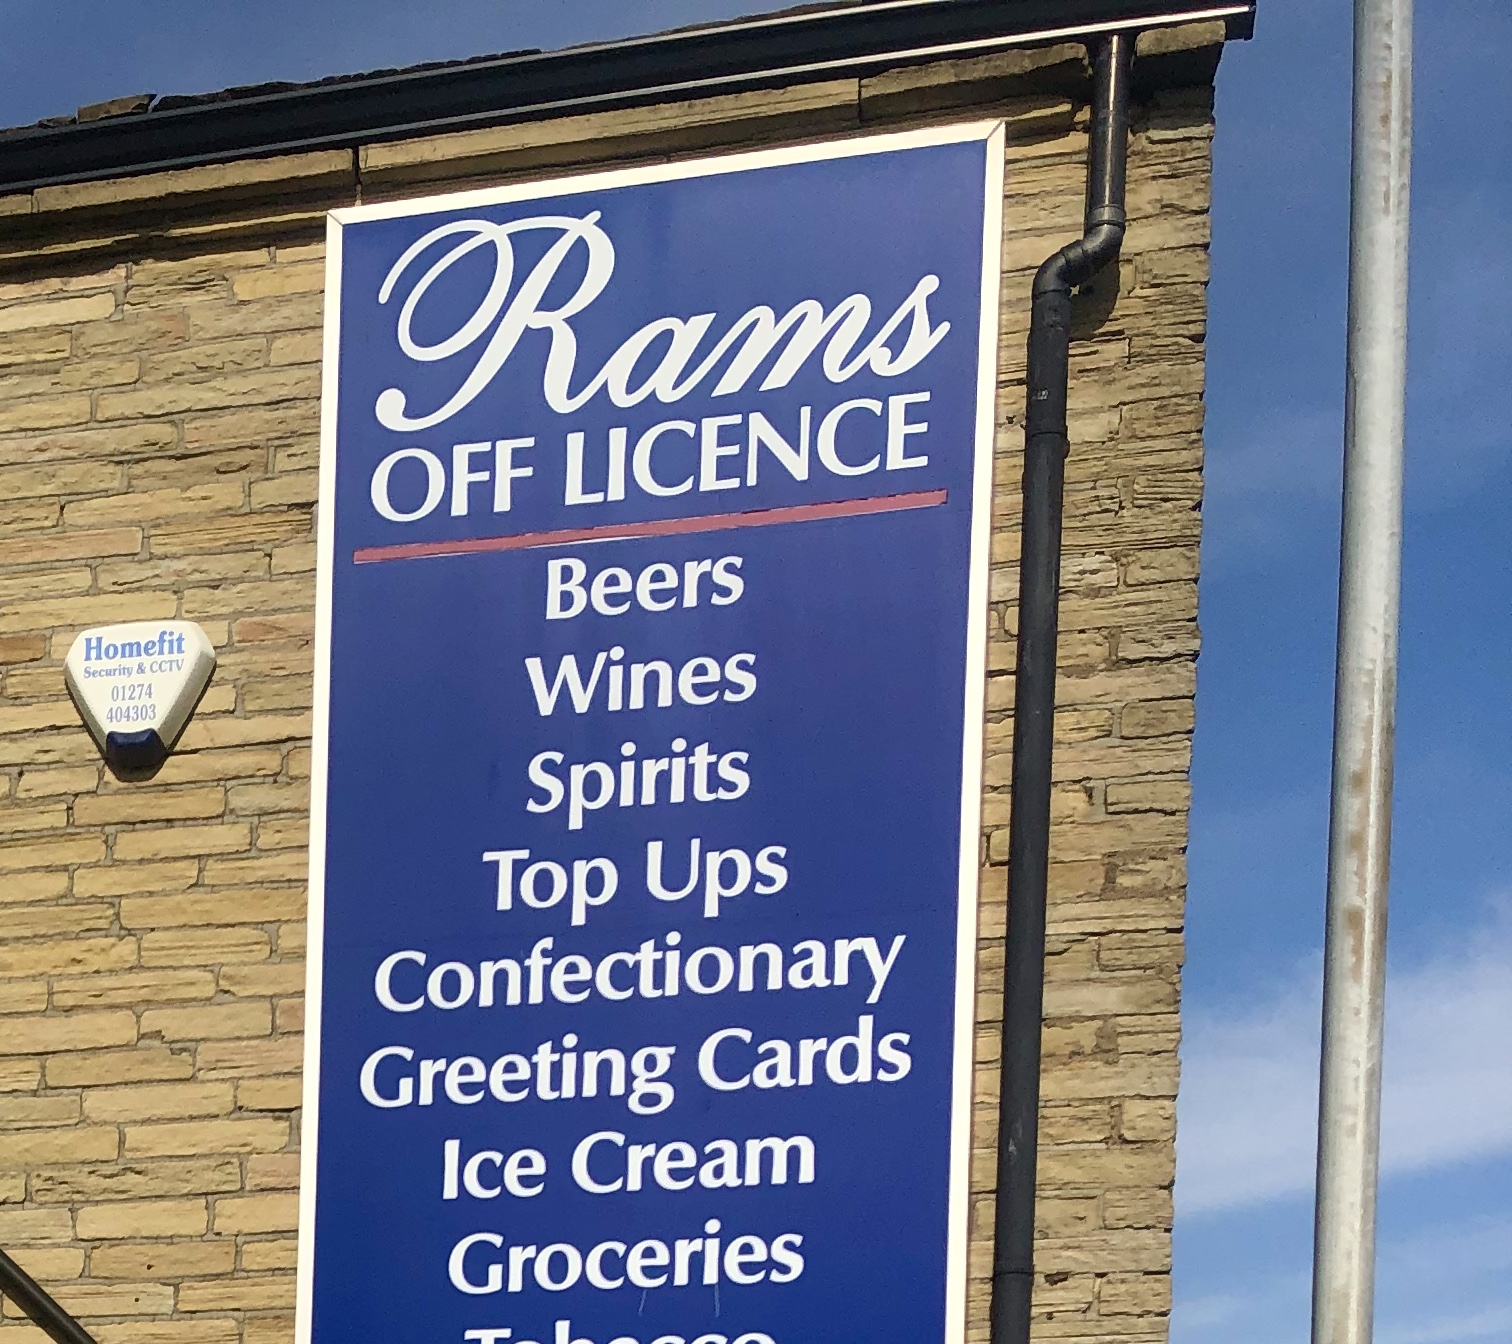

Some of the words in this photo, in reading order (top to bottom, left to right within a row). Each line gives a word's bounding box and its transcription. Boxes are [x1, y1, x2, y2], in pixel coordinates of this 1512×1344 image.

[376, 211, 950, 431] Rams
[371, 437, 535, 522] OFF
[565, 392, 931, 505] LICENCE
[545, 555, 745, 619] Beers
[83, 630, 186, 661] Homefit
[83, 662, 133, 679] Security
[136, 662, 146, 675] &
[149, 659, 185, 674] CCTV
[524, 646, 757, 717] Wines
[106, 703, 157, 723] 404303
[111, 683, 153, 702] 01274
[526, 738, 750, 830] Spirits
[482, 850, 618, 926] Top
[646, 838, 788, 918] Ups
[374, 932, 906, 1012] Confectionary
[360, 1034, 676, 1115] Greeting
[698, 1015, 912, 1091] Cards
[442, 1139, 547, 1200] Ice
[571, 1132, 815, 1194] Cream
[448, 1219, 804, 1294] Groceries
